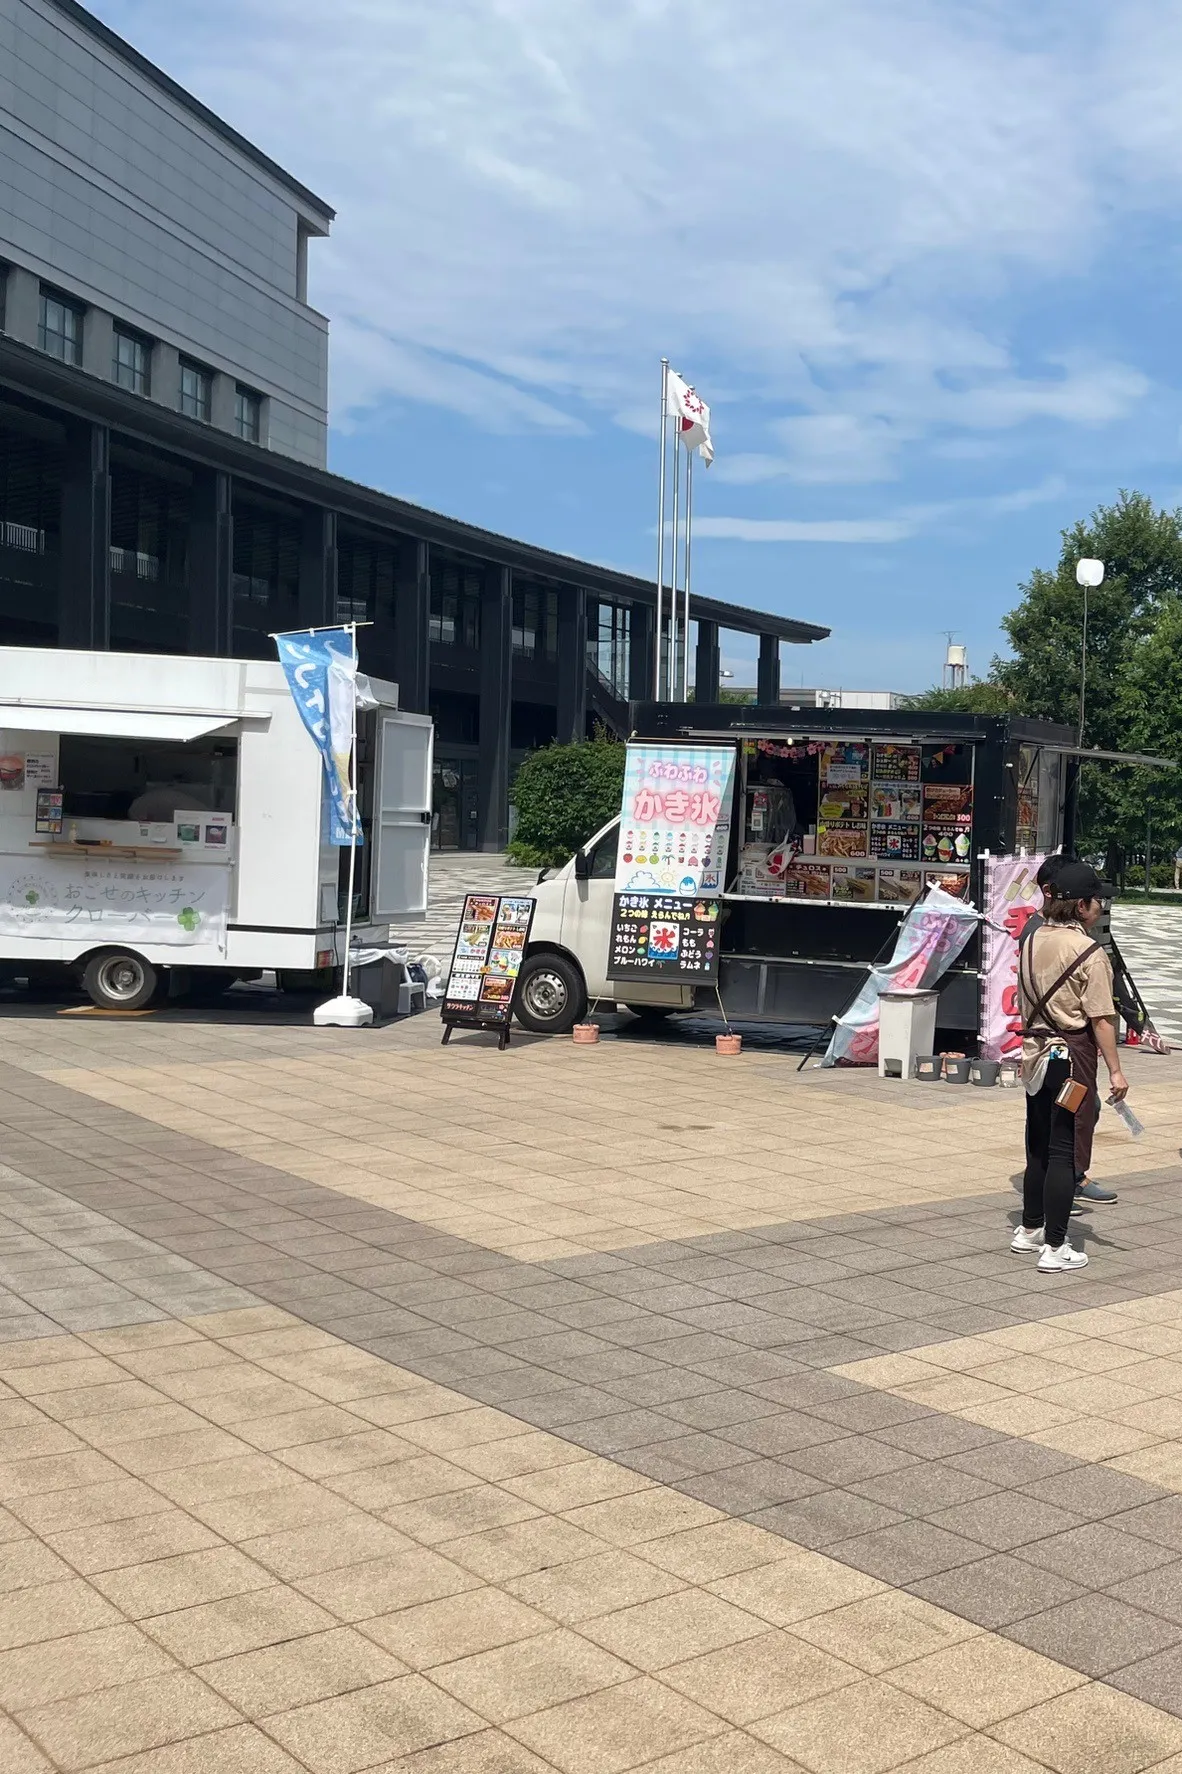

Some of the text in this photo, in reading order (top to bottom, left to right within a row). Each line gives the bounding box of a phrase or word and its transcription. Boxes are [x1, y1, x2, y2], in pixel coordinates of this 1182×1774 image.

[649, 761, 708, 783] ふわふわ
[634, 788, 721, 826] かき氷
[65, 883, 206, 904] おごせのキッチン
[619, 896, 693, 910] かき氷 メニュー
[65, 904, 174, 923] クローバー
[616, 924, 638, 933] いちご
[683, 928, 704, 936] コーラ
[615, 935, 637, 943] れもん
[653, 927, 676, 949] 氷
[682, 939, 696, 947] もも
[614, 946, 636, 954] メロン
[681, 950, 702, 959] ぶどう
[613, 956, 656, 967] ブルーハワイ
[680, 961, 701, 970] ラムネ
